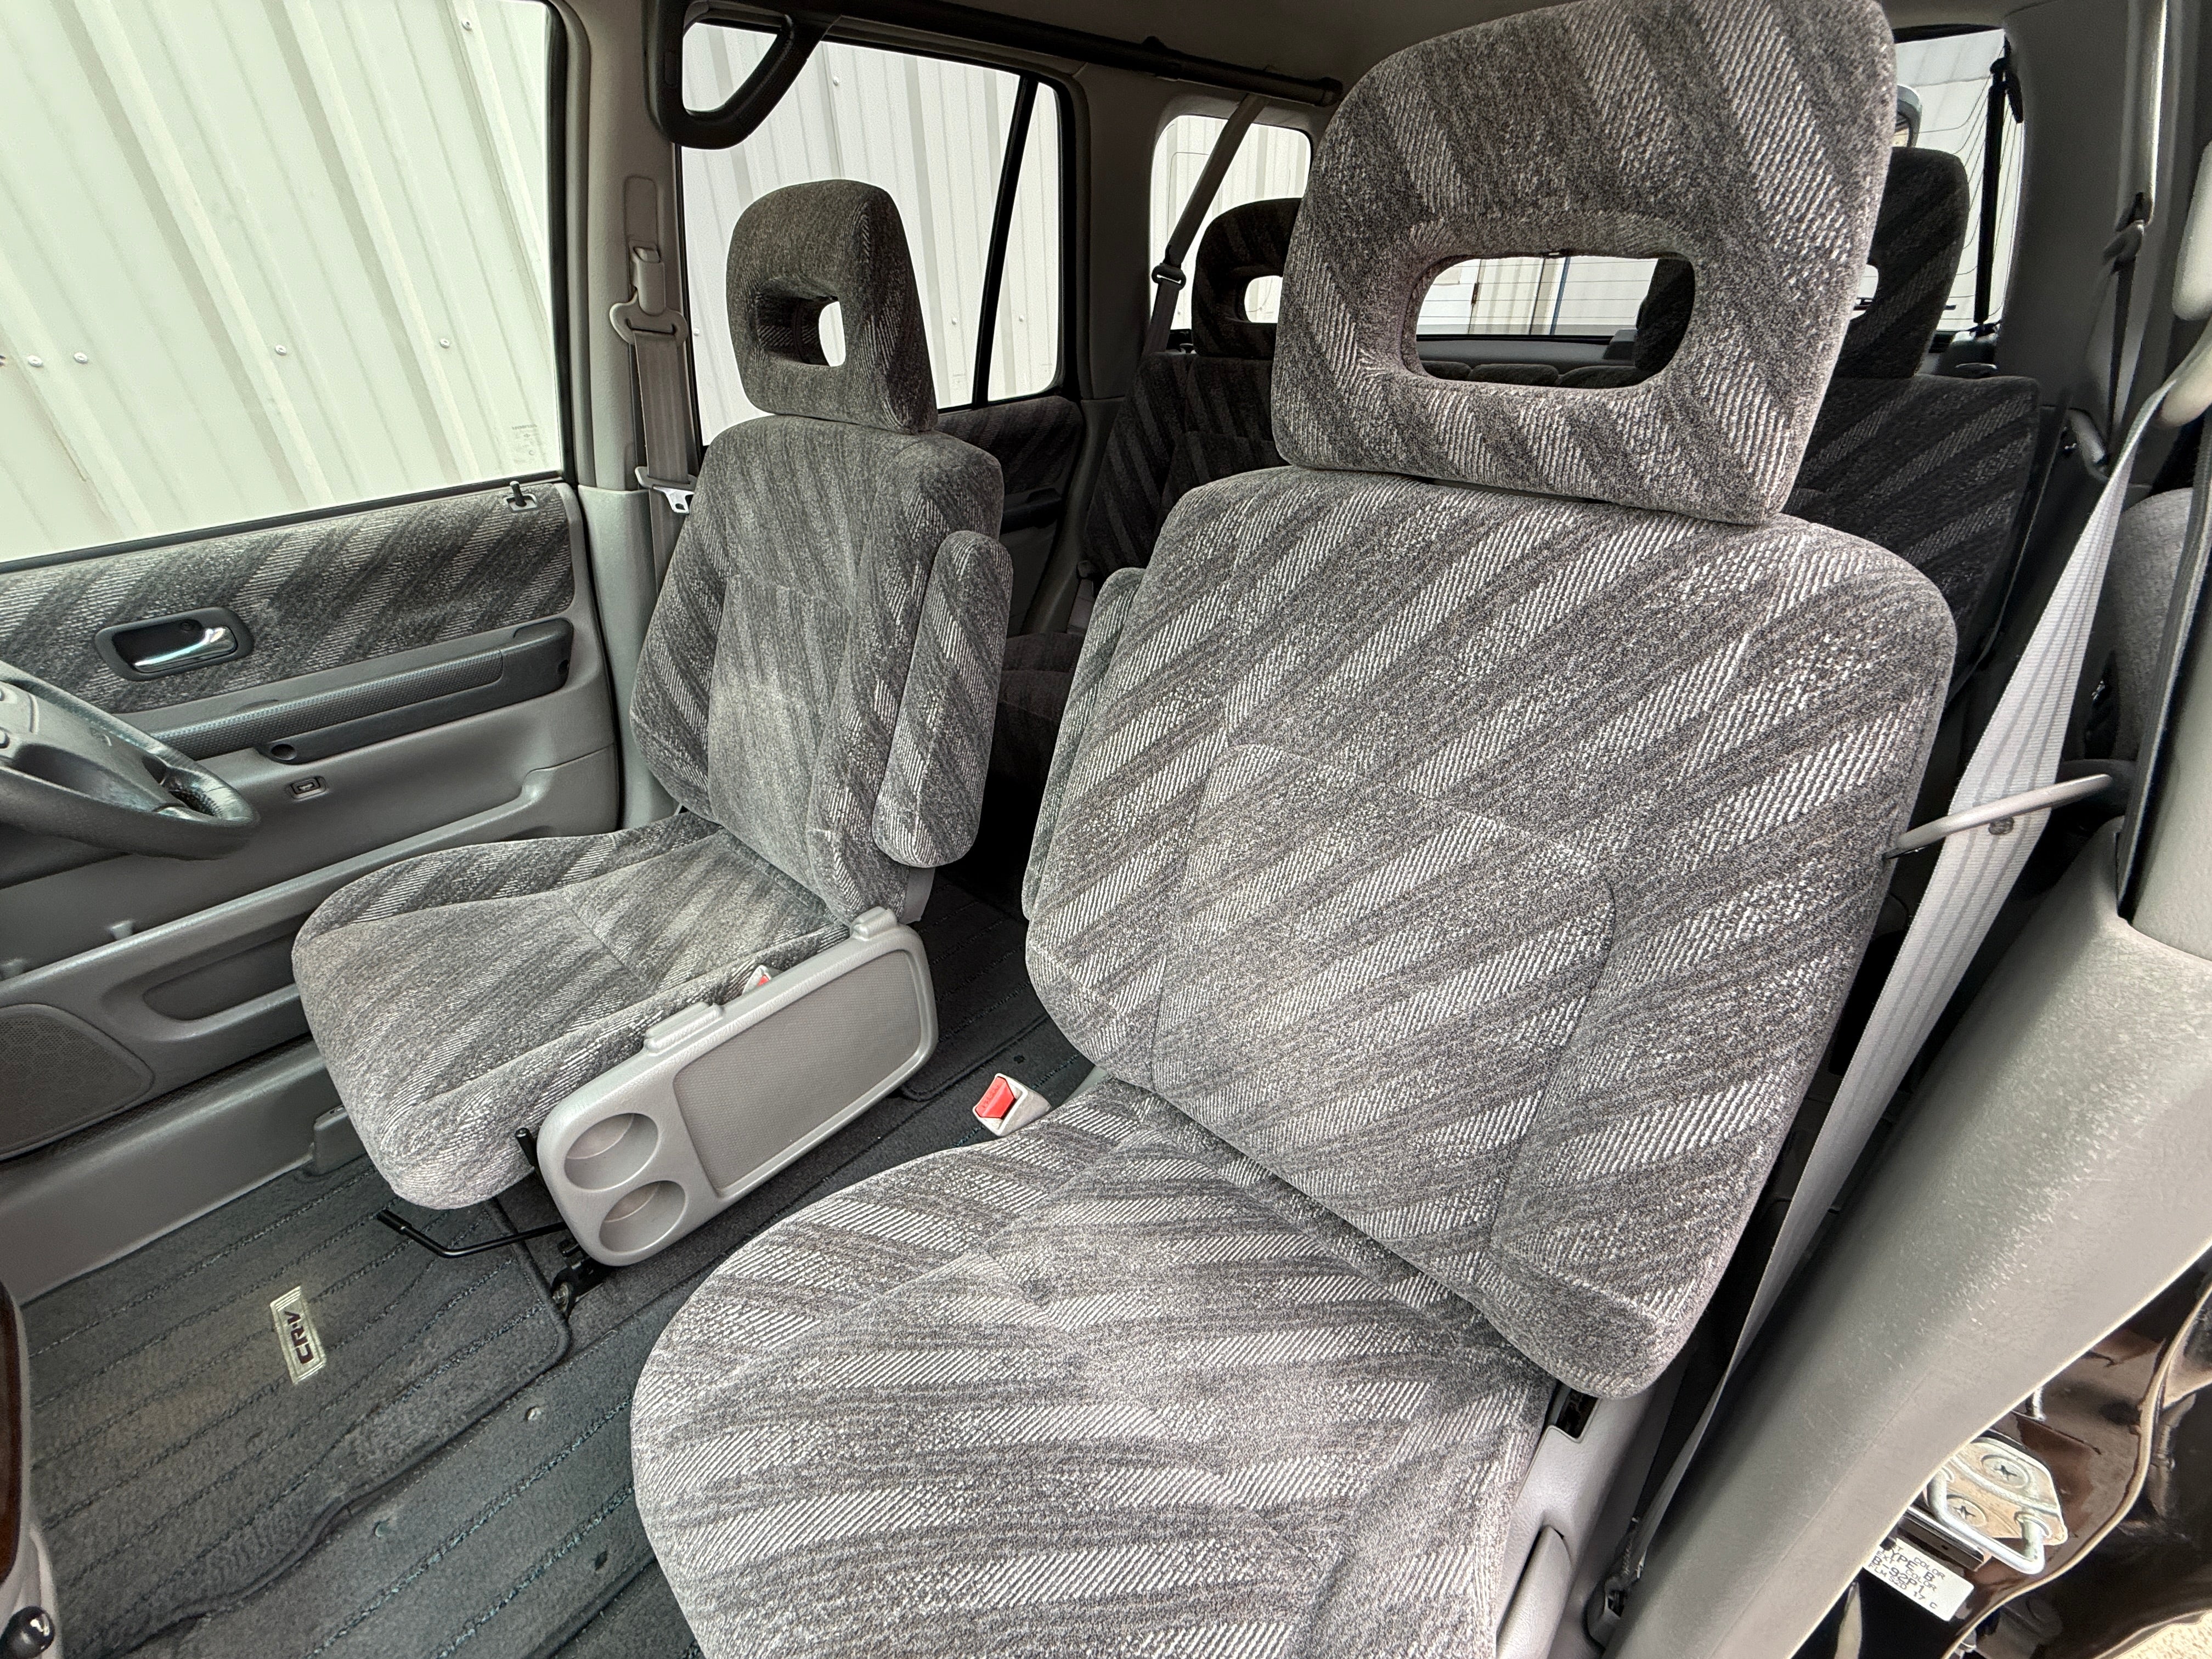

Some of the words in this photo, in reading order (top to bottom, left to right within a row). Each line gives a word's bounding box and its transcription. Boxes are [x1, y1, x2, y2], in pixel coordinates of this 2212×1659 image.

[284, 1311, 314, 1364] CR-V
[1871, 1555, 1925, 1593] B-92P1
[1913, 1557, 1945, 1580] COLOR
[1923, 1571, 1936, 1582] B
[1905, 1569, 1937, 1592] COLOR
